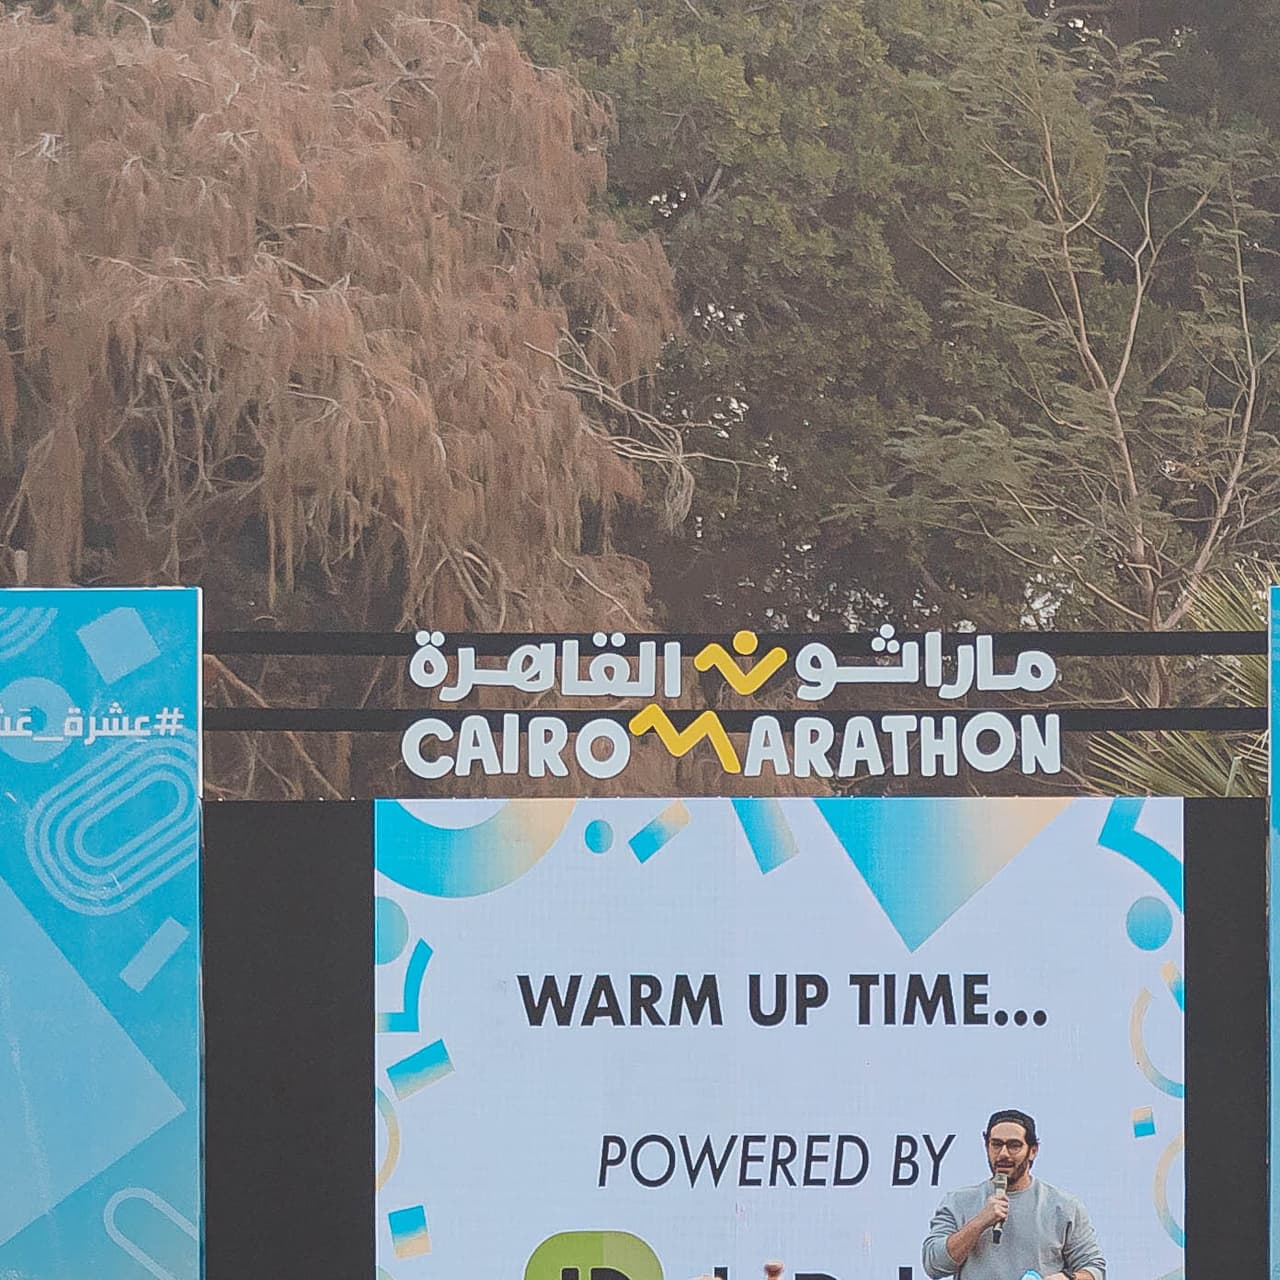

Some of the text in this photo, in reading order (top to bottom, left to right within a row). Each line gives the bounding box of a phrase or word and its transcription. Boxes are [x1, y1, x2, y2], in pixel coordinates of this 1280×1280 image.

[409, 630, 682, 701] القاهرة
[401, 712, 631, 780] CAIRO
[517, 974, 1048, 1027] WARM UP TIME...
[598, 1134, 957, 1188] POWERED BY
